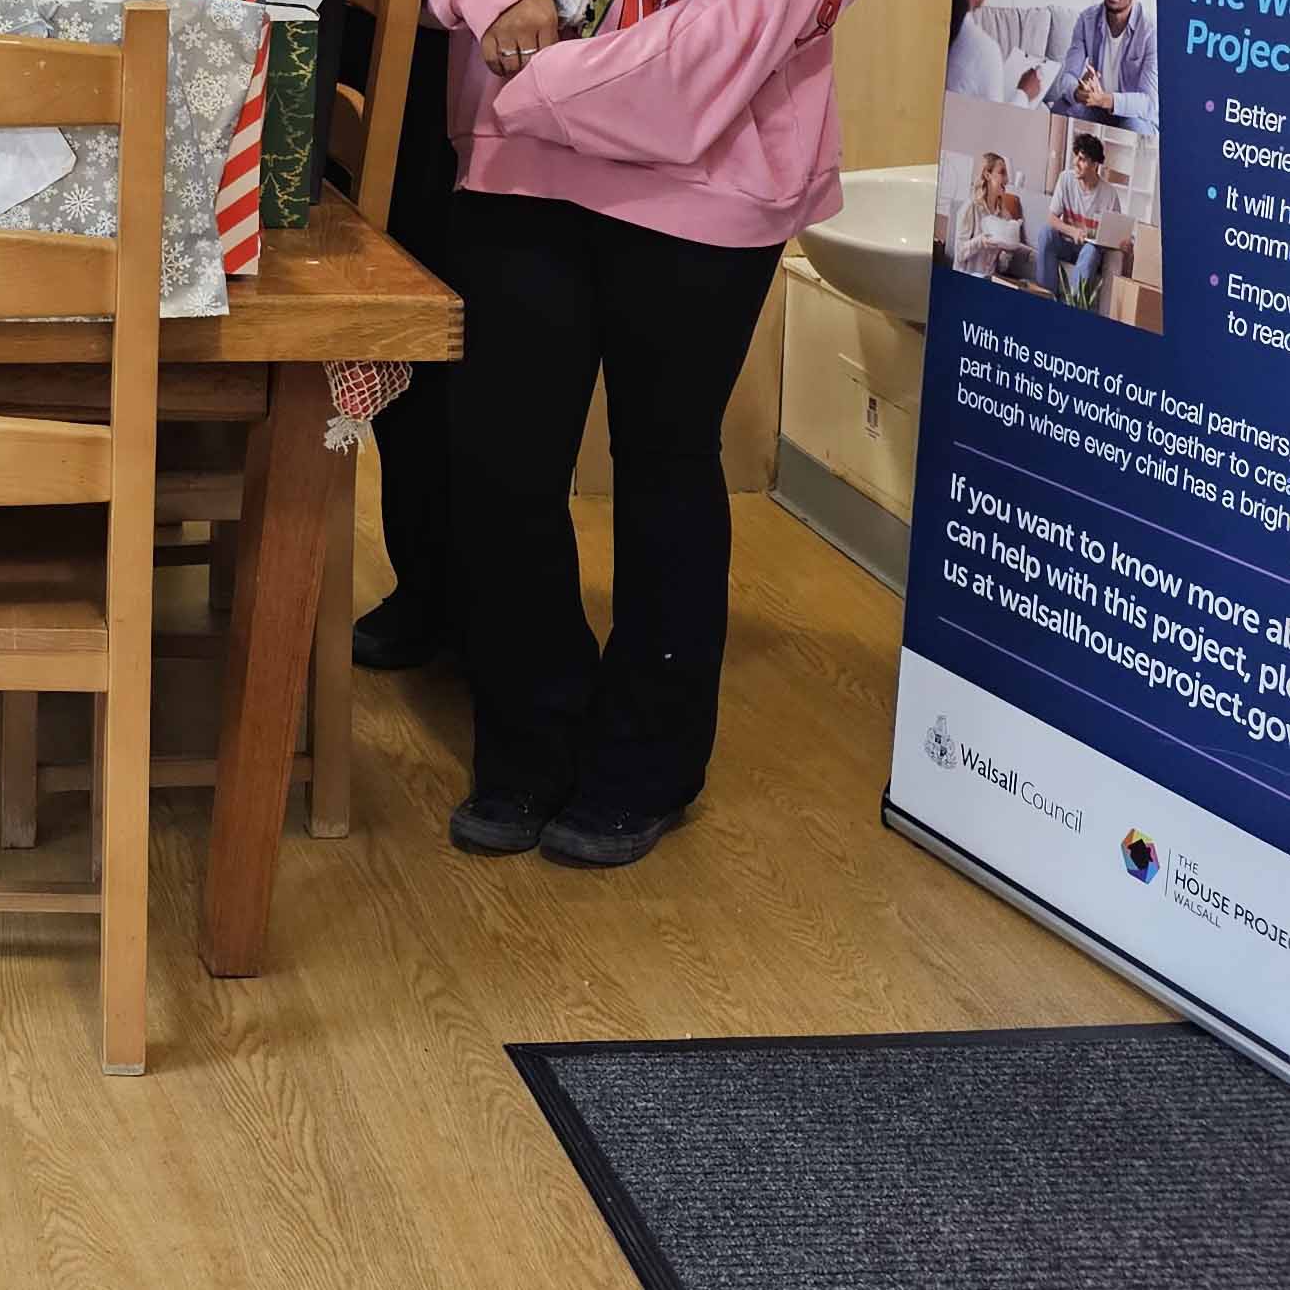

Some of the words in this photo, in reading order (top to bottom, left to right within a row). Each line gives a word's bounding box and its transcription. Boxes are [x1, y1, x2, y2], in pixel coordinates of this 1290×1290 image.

[1185, 19, 1290, 74] Projec
[1225, 98, 1287, 133] Better
[1226, 185, 1239, 212] It
[1244, 194, 1275, 220] will
[1227, 273, 1290, 312] Empo
[1227, 310, 1248, 337] to
[962, 320, 999, 354] With
[1003, 335, 1030, 363] the
[1033, 350, 1101, 390] support
[1103, 373, 1124, 395] of
[1126, 383, 1158, 407] our
[1161, 390, 1204, 426] local
[960, 356, 992, 383] part
[996, 365, 1010, 389] in
[1014, 372, 1044, 400] this
[1047, 387, 1069, 414] by
[1073, 396, 1142, 443] working
[1146, 420, 1225, 469] together
[1229, 451, 1250, 478] to
[957, 384, 1025, 427] borough
[1028, 412, 1080, 449] where
[1084, 435, 1133, 472] every
[1135, 453, 1178, 487] child
[1182, 468, 1217, 502] has
[1221, 489, 1235, 510] a
[944, 559, 969, 589] us
[972, 573, 994, 601] at
[950, 473, 966, 502] If
[968, 490, 1011, 523] you
[1016, 507, 1075, 552] want
[1079, 530, 1106, 565] to
[1111, 542, 1183, 598] know
[1188, 582, 1260, 634] more
[946, 519, 986, 555] can
[991, 533, 1041, 583] help
[1046, 564, 1098, 607] with
[1103, 586, 1147, 630] this
[1152, 613, 1251, 683] project,
[960, 742, 1018, 795] Walsall
[1021, 781, 1083, 834] Council
[1178, 854, 1199, 876] THE
[1173, 890, 1222, 929] WALSALL
[1174, 869, 1231, 916] HOUSE
[1234, 903, 1290, 950] PROJE
